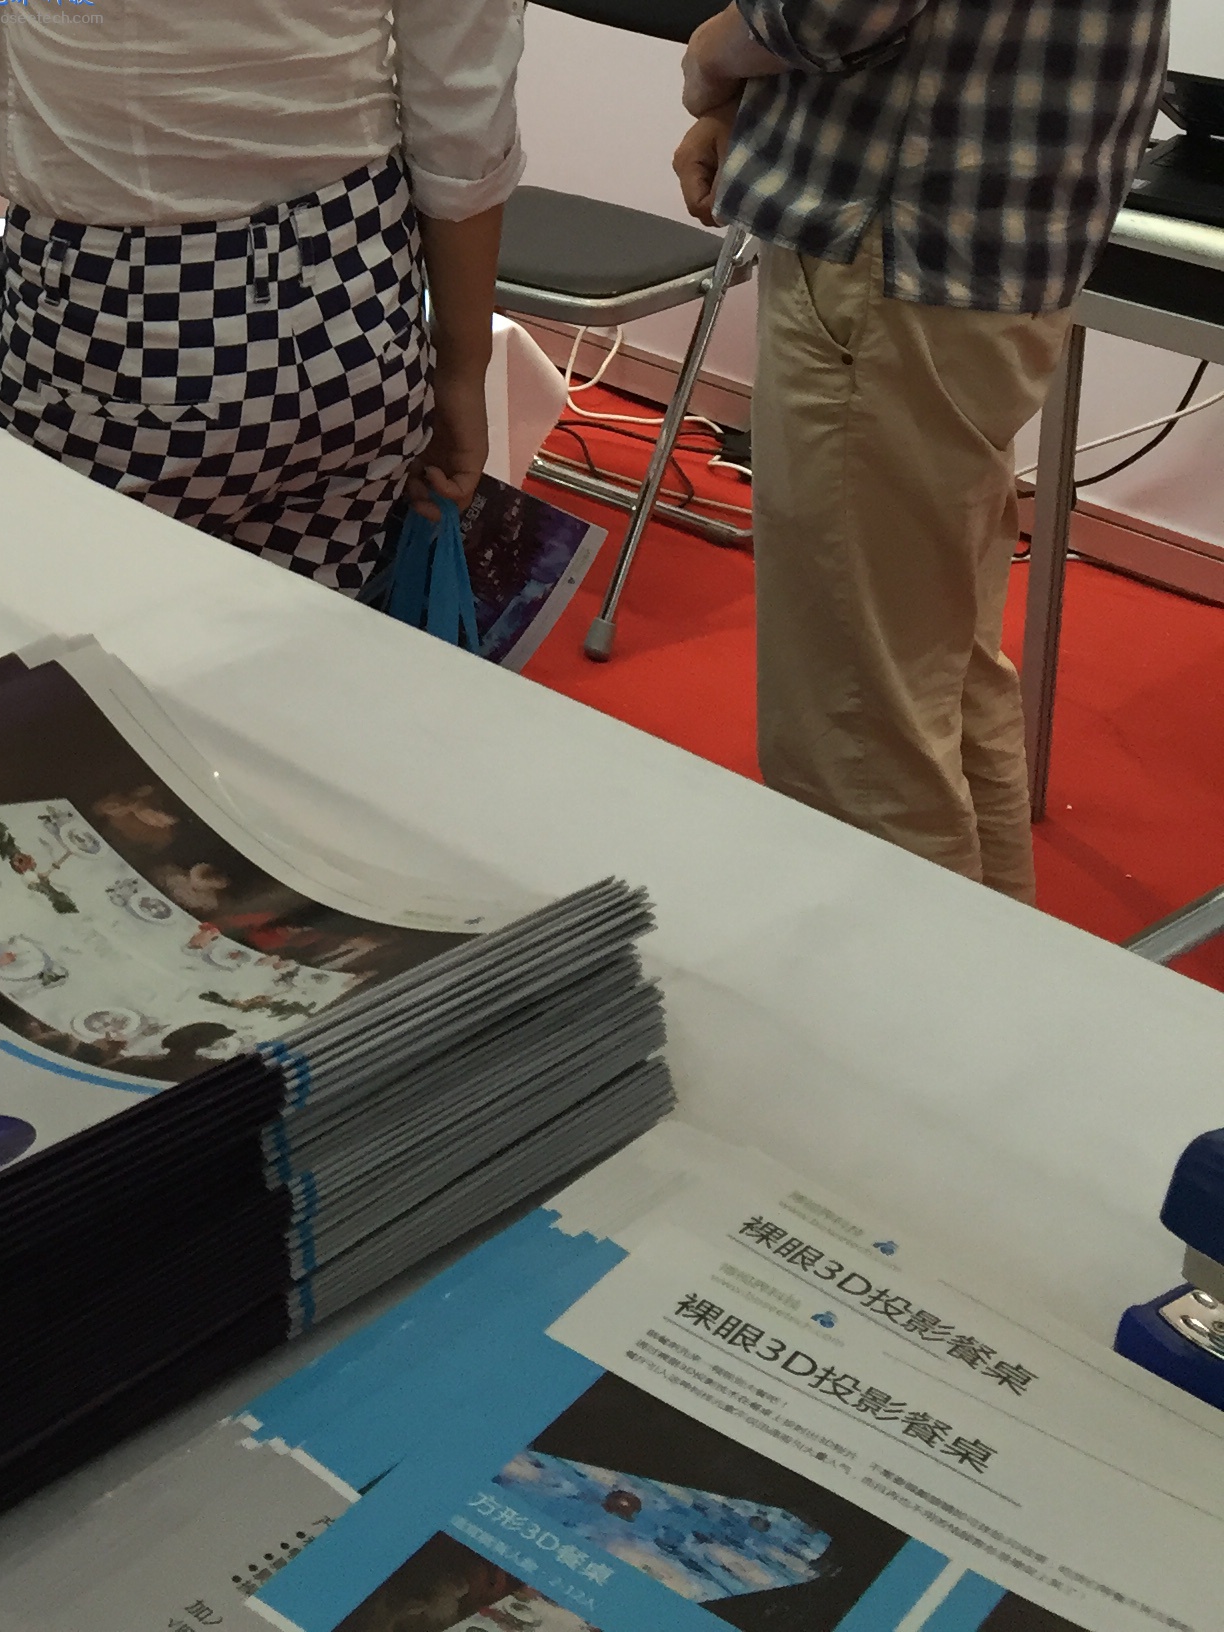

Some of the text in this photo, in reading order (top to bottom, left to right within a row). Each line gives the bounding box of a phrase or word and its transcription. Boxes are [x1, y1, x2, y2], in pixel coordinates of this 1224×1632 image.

[672, 1291, 1000, 1476] 裸眼3D投影餐桌
[737, 1212, 1041, 1399] 裸眼3D投影餐桌
[466, 1491, 616, 1587] 方形3D餐桌
